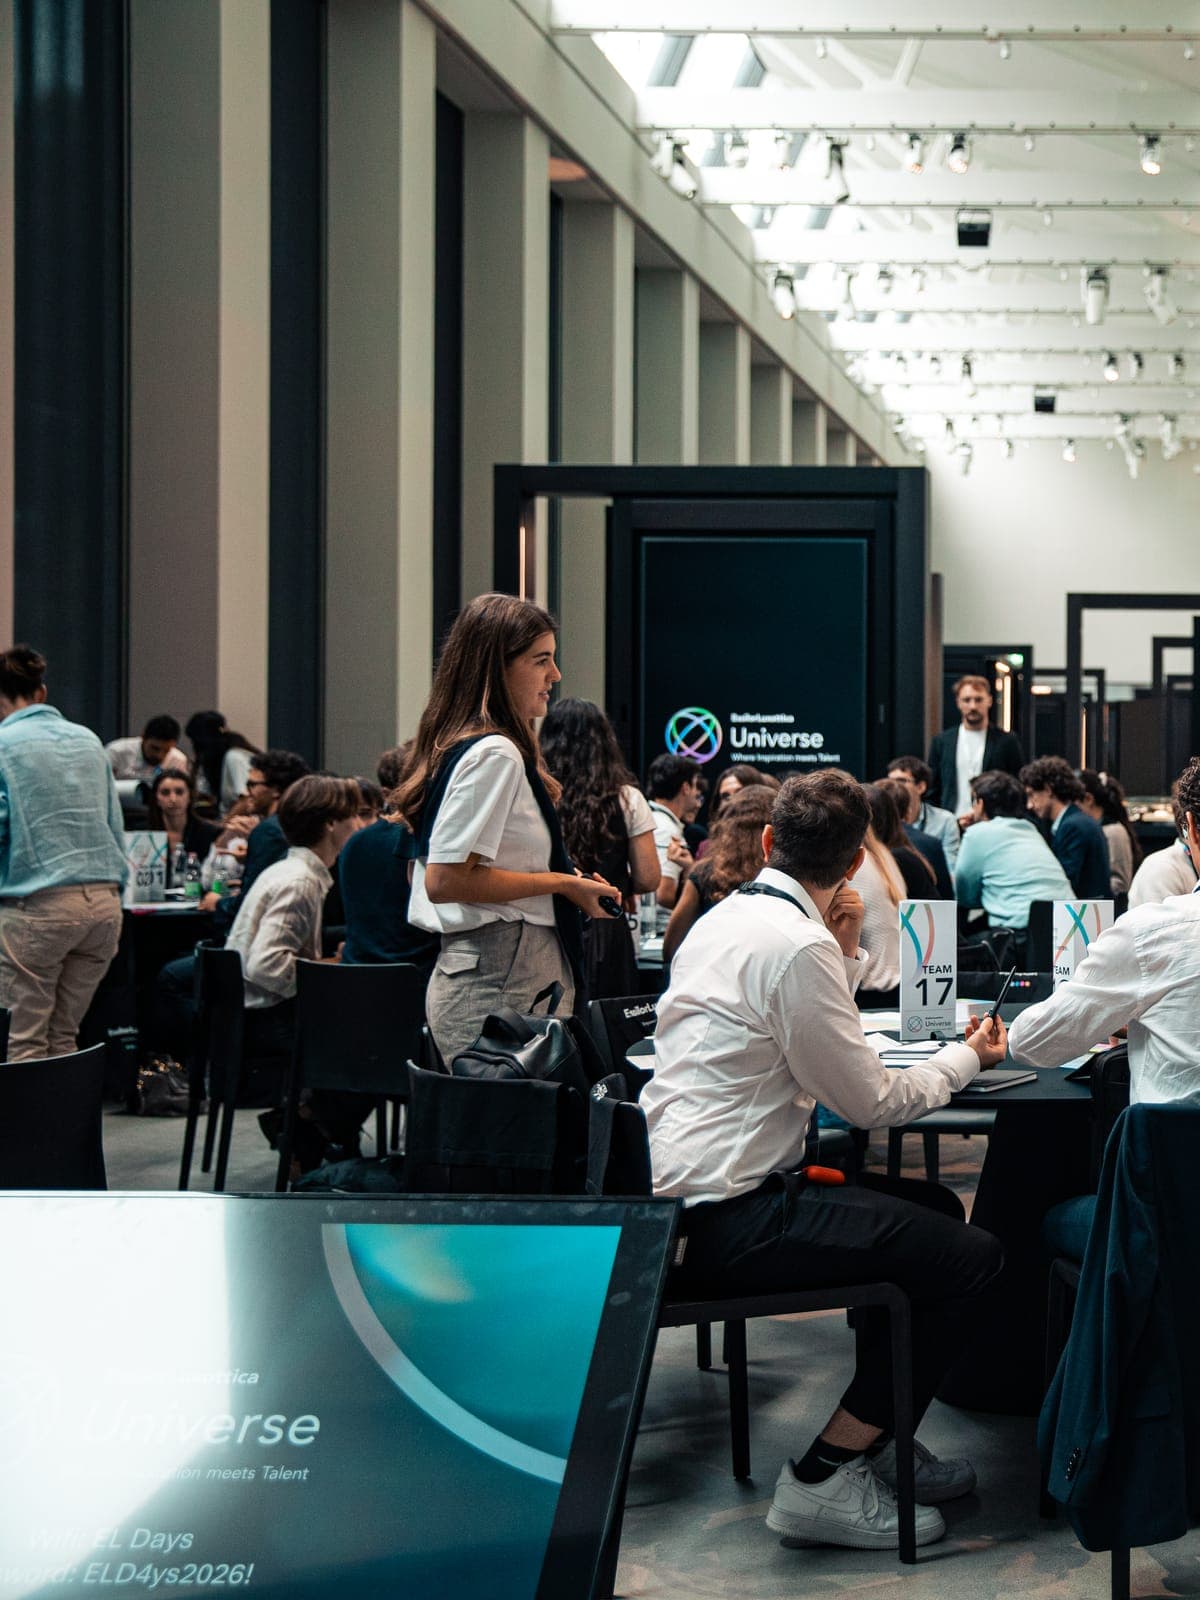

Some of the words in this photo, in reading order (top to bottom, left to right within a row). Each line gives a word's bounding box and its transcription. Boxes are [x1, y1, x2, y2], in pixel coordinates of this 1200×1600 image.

[730, 726, 824, 749] Universe
[922, 965, 952, 975] TEAM
[1054, 965, 1070, 976] EAM
[915, 977, 953, 1006] 17
[206, 1466, 256, 1480] meets
[262, 1465, 310, 1480] Talent
[94, 1528, 122, 1549] EL
[130, 1528, 194, 1553] Days
[83, 1563, 255, 1589] ELD4ys2026!
